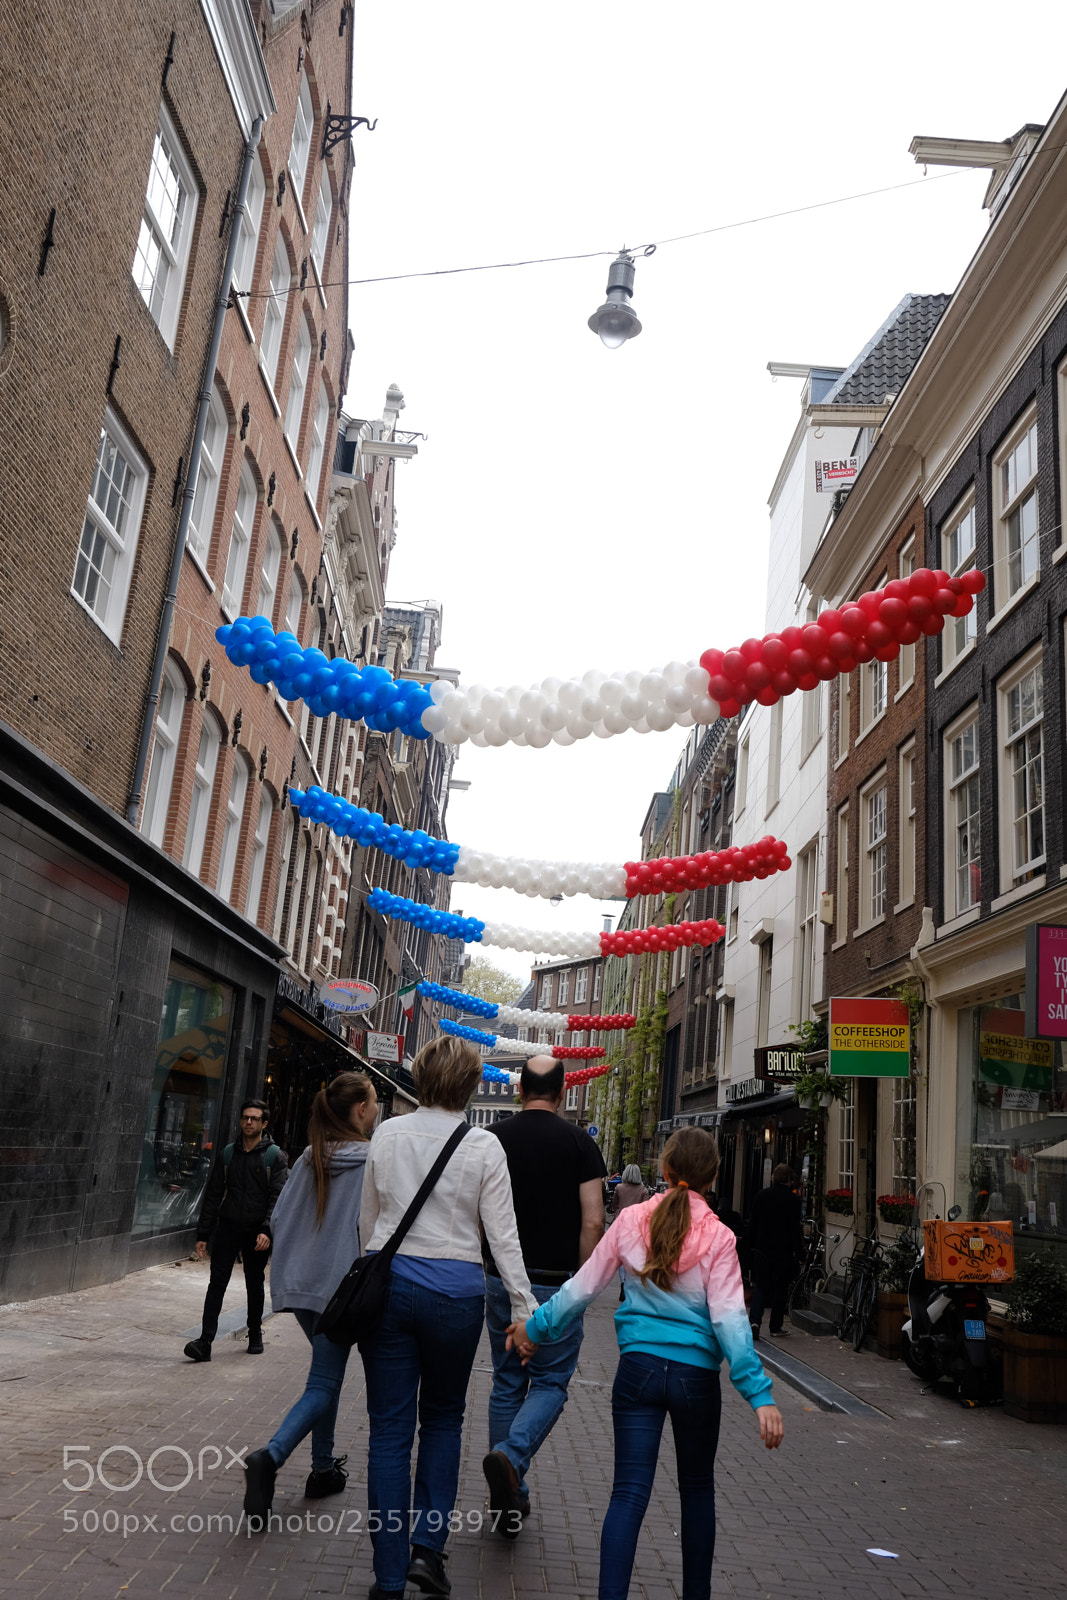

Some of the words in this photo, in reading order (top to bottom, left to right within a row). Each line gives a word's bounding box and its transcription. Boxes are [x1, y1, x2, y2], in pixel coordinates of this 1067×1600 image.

[823, 460, 848, 471] BEN
[328, 981, 372, 994] SATURNINO
[323, 998, 370, 1012] RISTORANTE
[834, 1026, 906, 1037] COFFEESHOP
[369, 1034, 398, 1049] Verona
[834, 1038, 852, 1048] THE
[854, 1039, 906, 1049] OTHERSIDE
